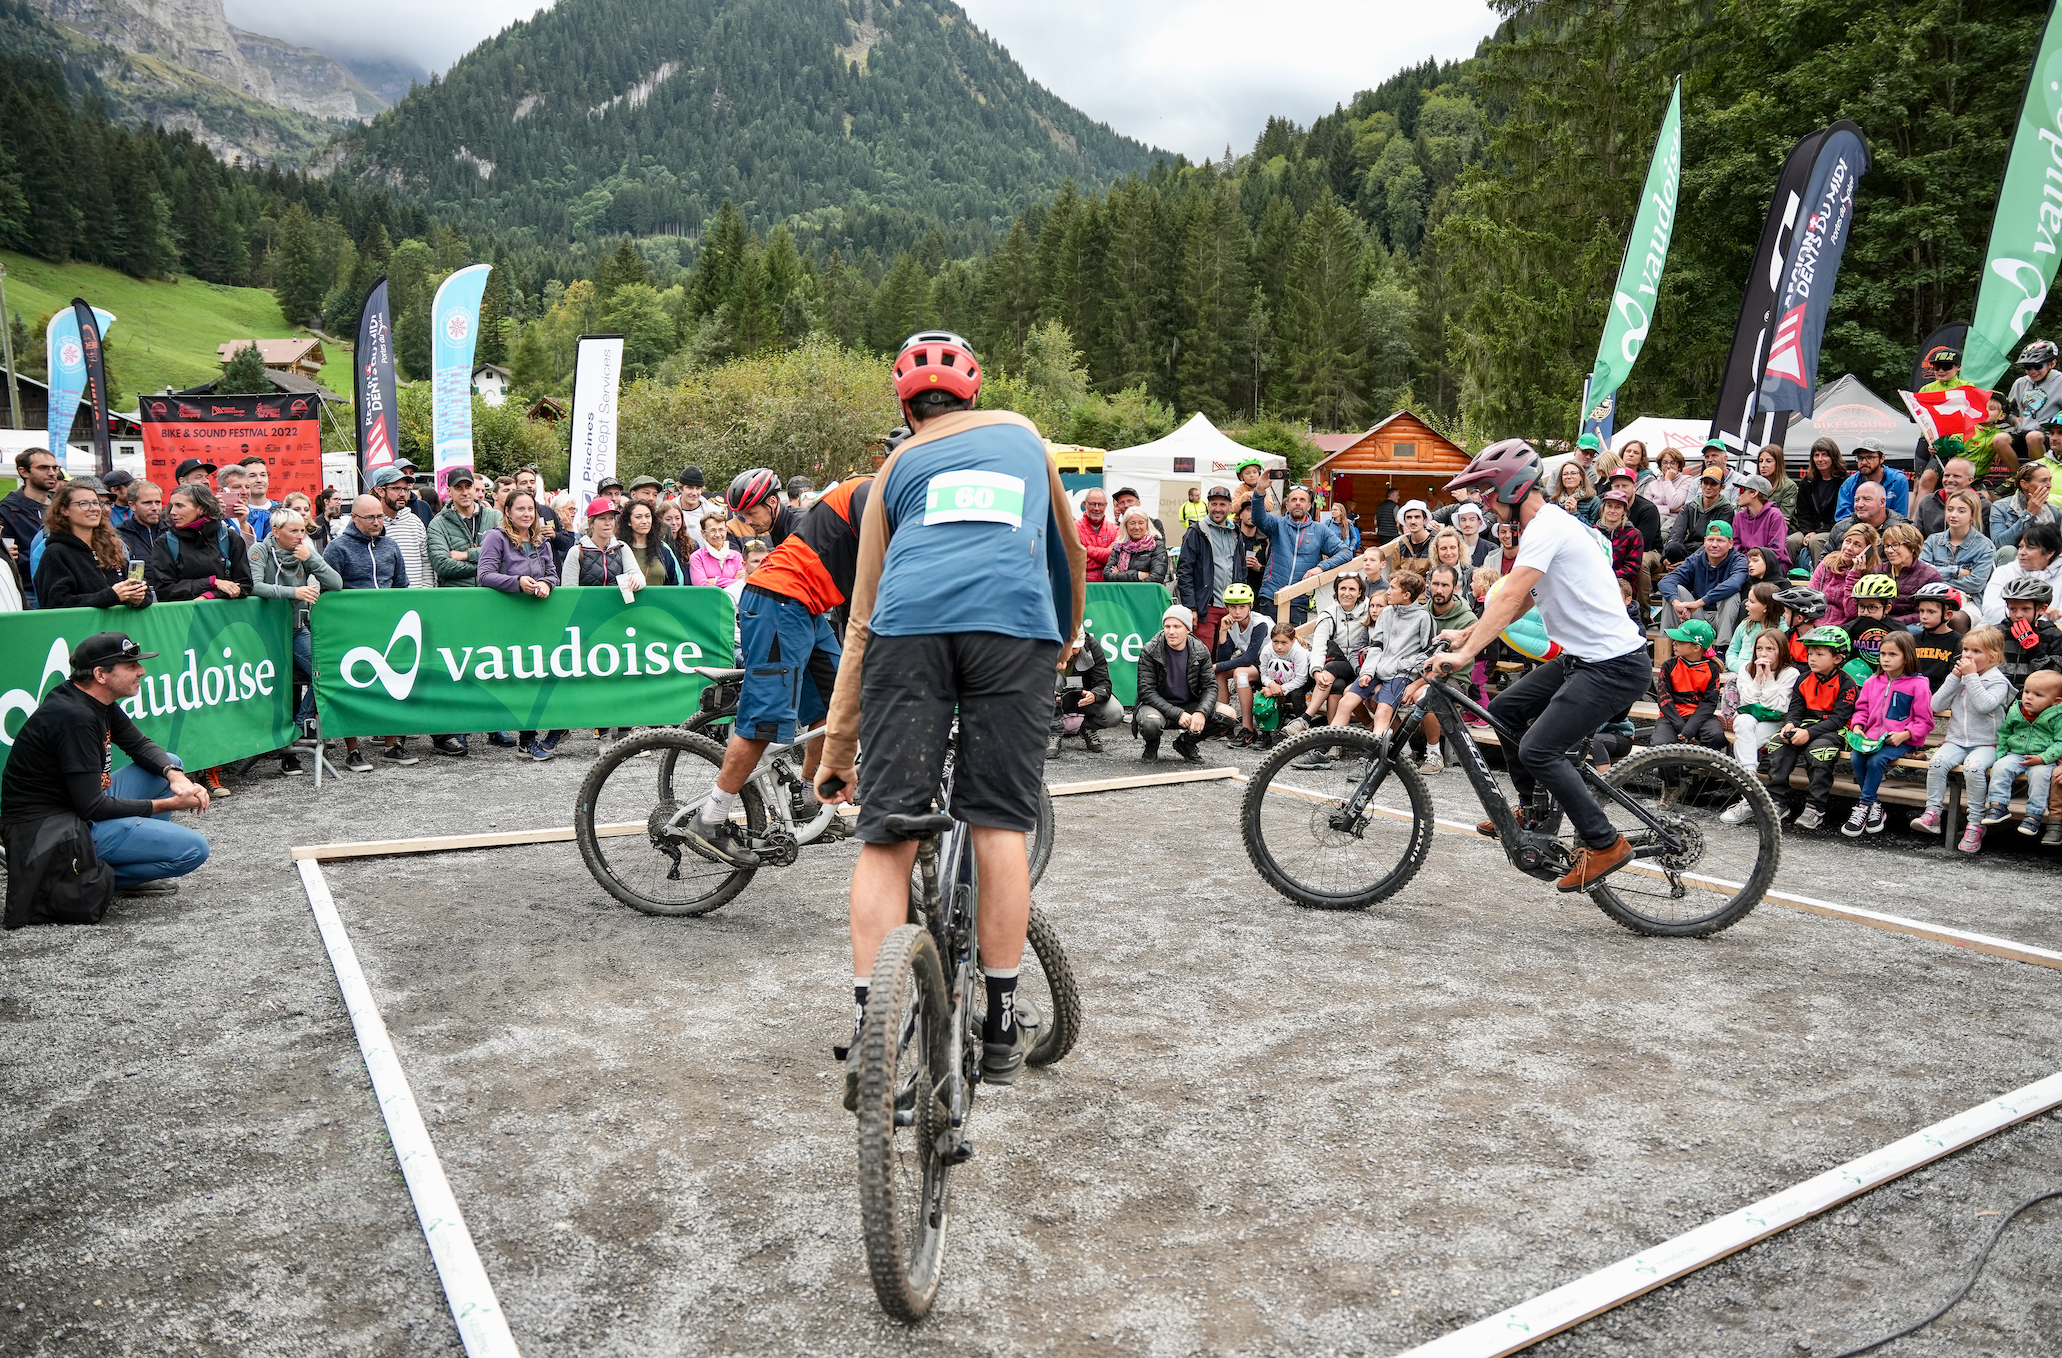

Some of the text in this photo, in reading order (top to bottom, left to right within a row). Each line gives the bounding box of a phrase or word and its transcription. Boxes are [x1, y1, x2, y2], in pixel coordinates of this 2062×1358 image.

[1796, 157, 1848, 298] DENTS DU MIDI
[161, 427, 298, 438] BIKE & SOUND FESTIVAL 2022
[592, 349, 611, 485] Concept Services
[582, 412, 594, 482] Piscines
[954, 486, 995, 509] 60
[1511, 478, 1534, 504] GIRO
[436, 626, 703, 682] vaudoise
[1915, 647, 1952, 662] UPERFOX
[119, 646, 276, 720] audoise
[1461, 730, 1503, 798] SCOTT
[1710, 761, 1753, 792] MAXXIS
[1410, 818, 1425, 863] MAXXIS
